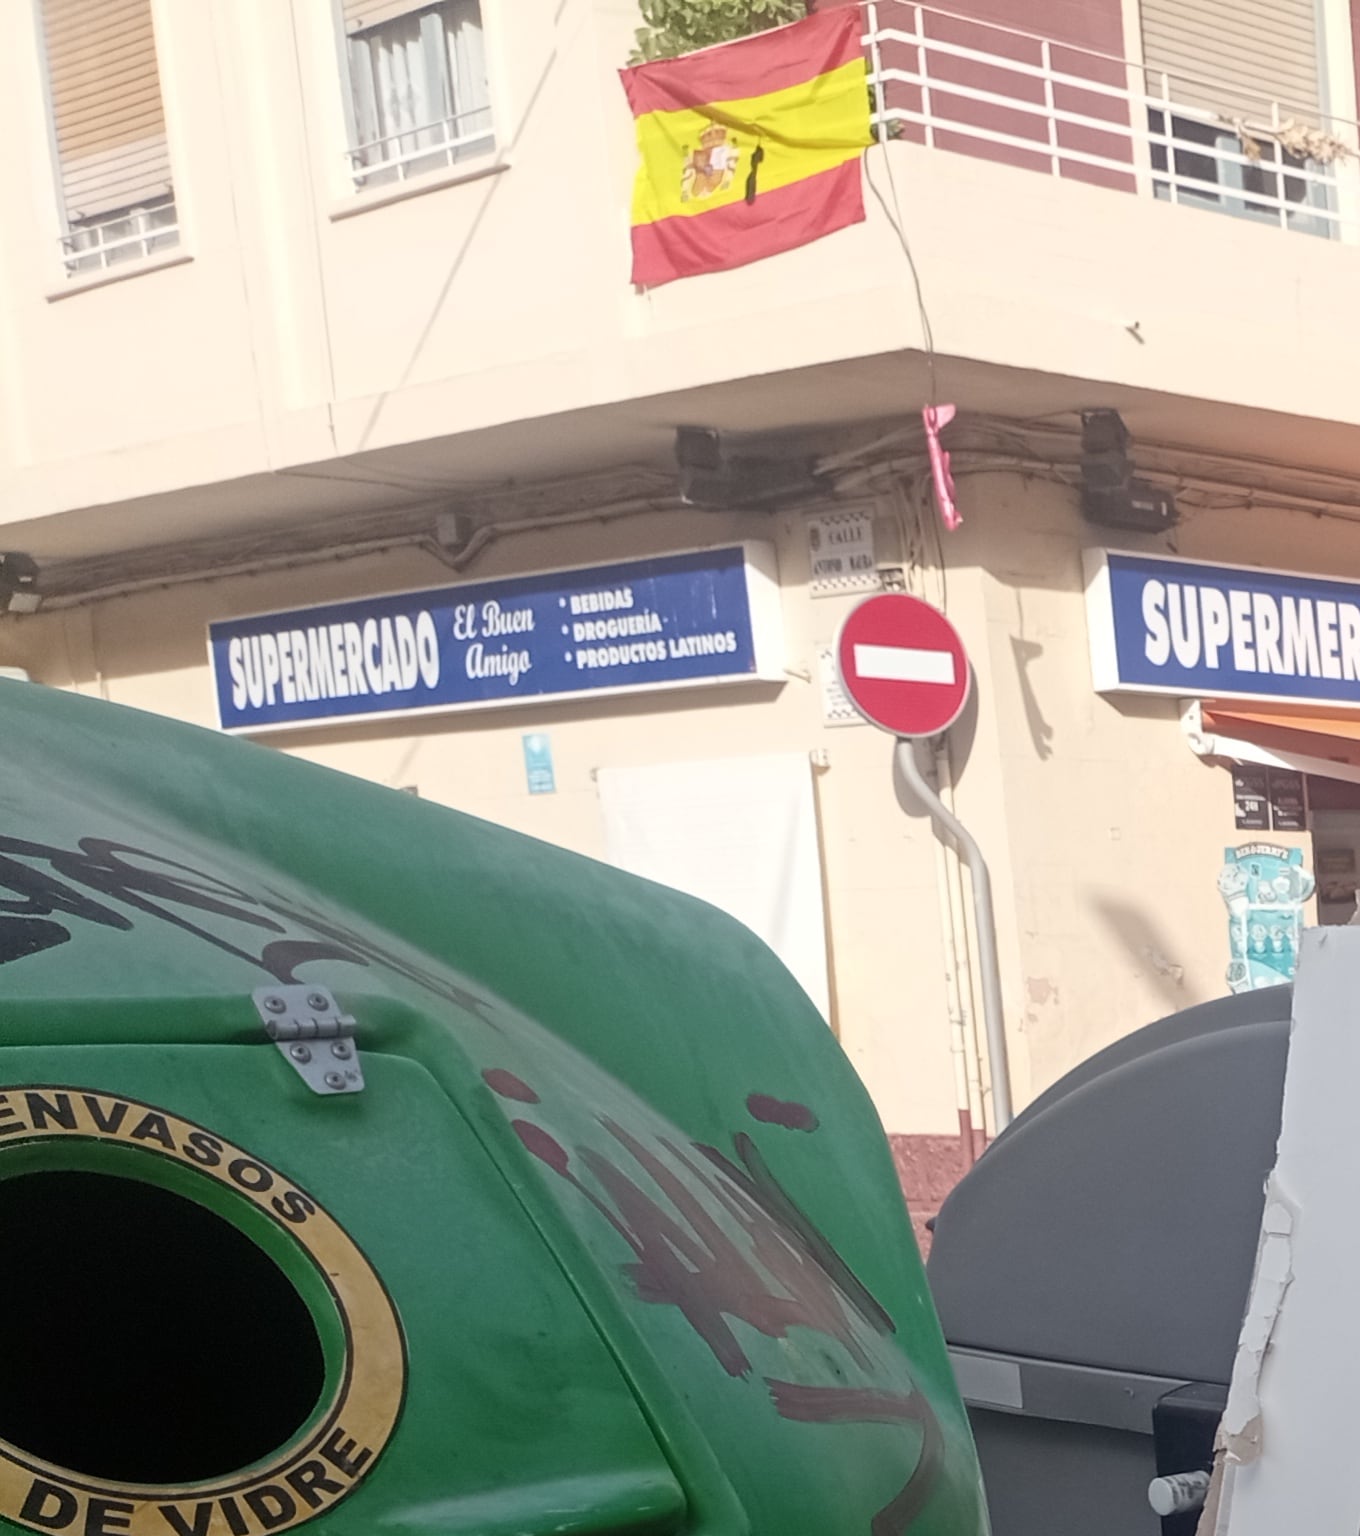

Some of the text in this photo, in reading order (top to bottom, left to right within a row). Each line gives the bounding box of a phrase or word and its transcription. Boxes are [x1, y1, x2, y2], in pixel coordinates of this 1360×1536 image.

[453, 600, 536, 641] El Buen
[570, 588, 635, 615] BEBIDAS
[573, 609, 663, 642] DROGUERÍA
[229, 610, 440, 710] SUPERMERCADO
[465, 643, 533, 686] Amigo
[576, 631, 738, 670] PRODUCTOS LATINOS
